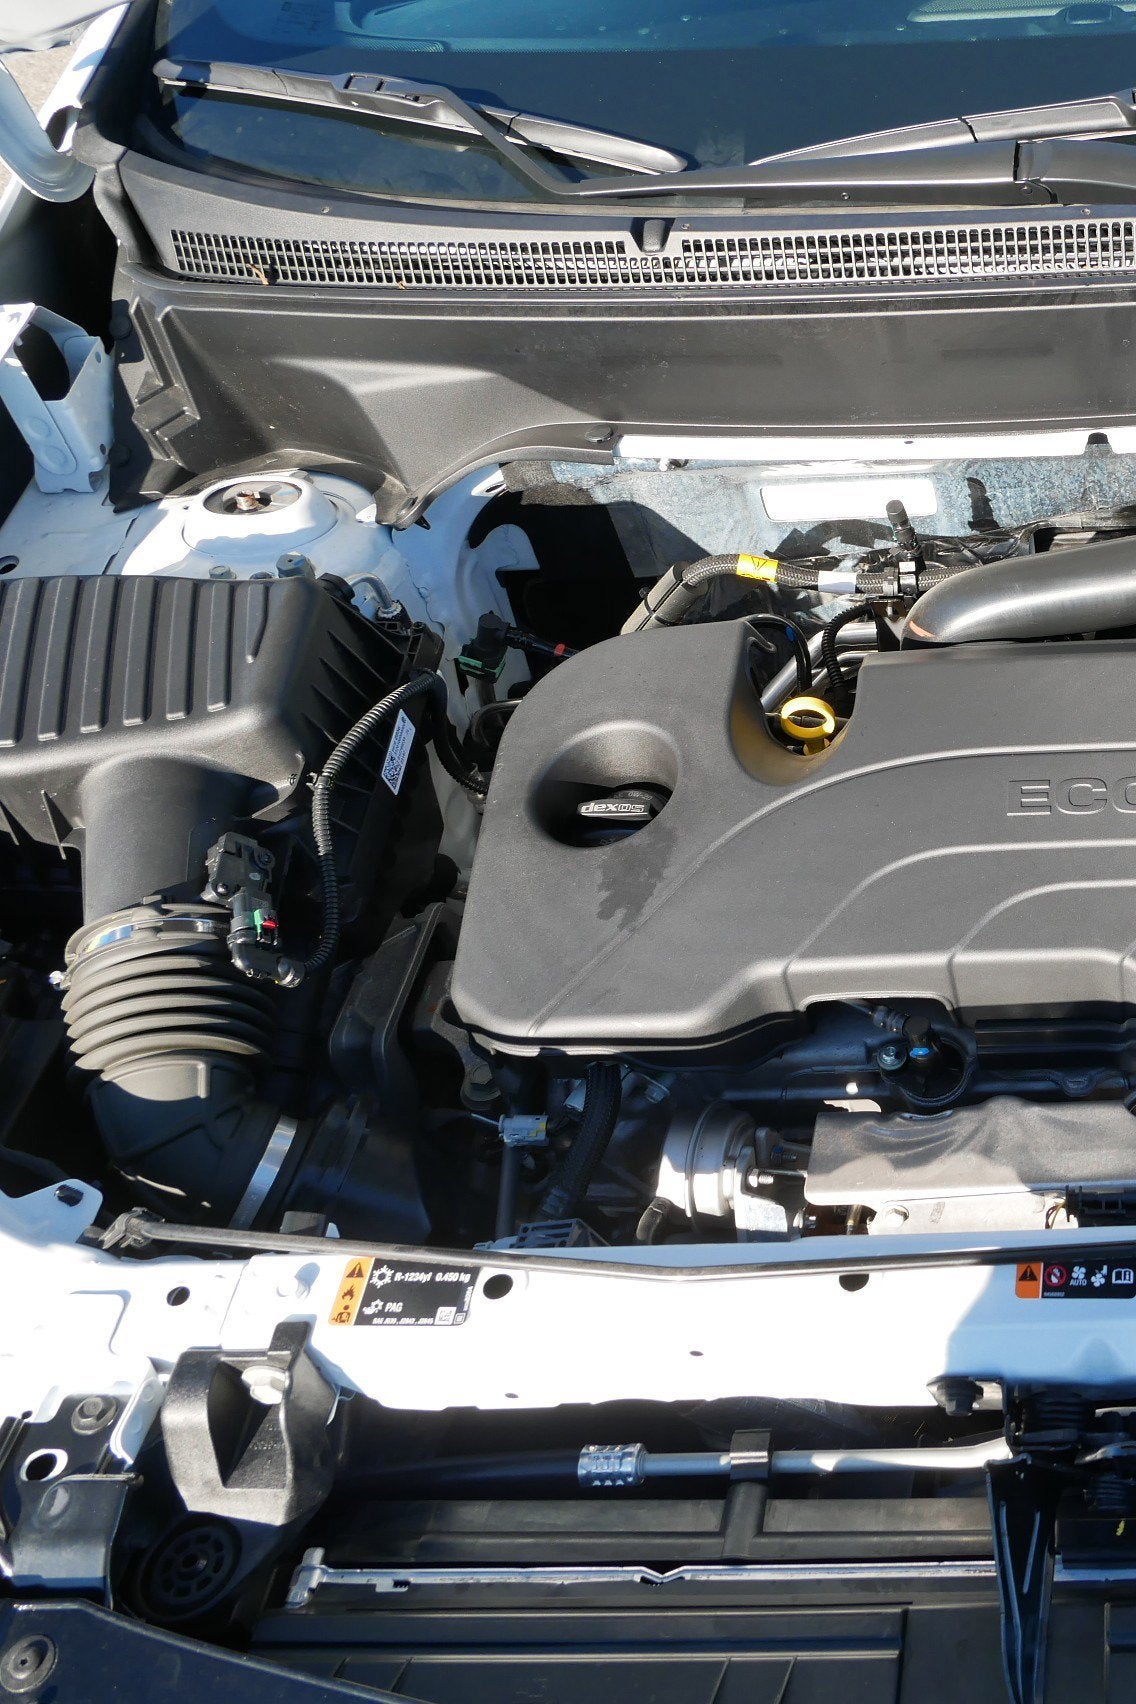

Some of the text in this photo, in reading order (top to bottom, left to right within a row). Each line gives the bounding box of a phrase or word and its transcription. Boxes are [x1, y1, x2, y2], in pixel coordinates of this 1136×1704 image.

[580, 802, 645, 813] dexos
[394, 1271, 471, 1284] R-1234yf 0.450 kg
[1069, 1279, 1087, 1287] AUTO
[384, 1302, 403, 1313] PAG
